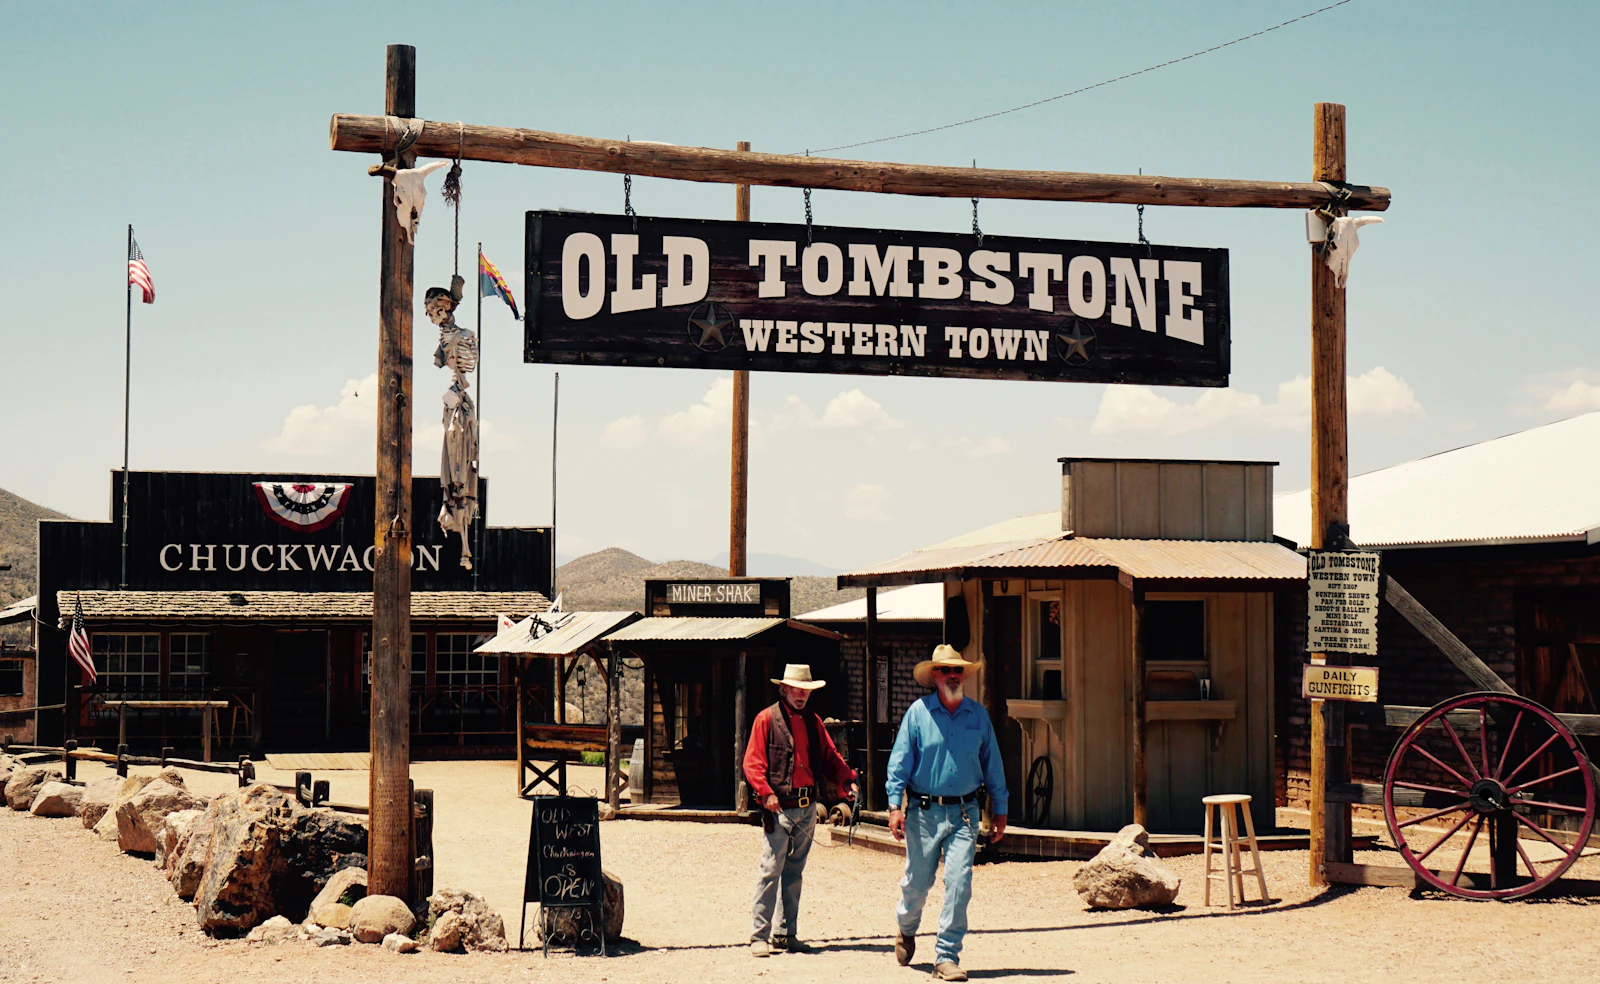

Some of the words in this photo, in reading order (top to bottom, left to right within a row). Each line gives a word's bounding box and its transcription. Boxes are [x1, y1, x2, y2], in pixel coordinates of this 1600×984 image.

[561, 231, 710, 321] OLD
[748, 239, 1205, 346] TOMBSTONE
[739, 319, 928, 358] WESTERN
[944, 326, 1050, 362] TOWN
[159, 543, 443, 572] CHUCKWAN
[1311, 555, 1326, 571] OLD
[1329, 556, 1376, 573] TOMBSTONE
[1312, 572, 1350, 581] WESTERN
[1353, 573, 1375, 582] TOWN
[672, 585, 711, 602] MINER
[715, 585, 753, 602] SHAK
[1323, 671, 1357, 681] DAILY
[1309, 682, 1370, 696] GUNFIGHTS
[541, 808, 571, 824] OLD
[555, 823, 594, 840] WEST
[544, 873, 595, 901] OPEN
